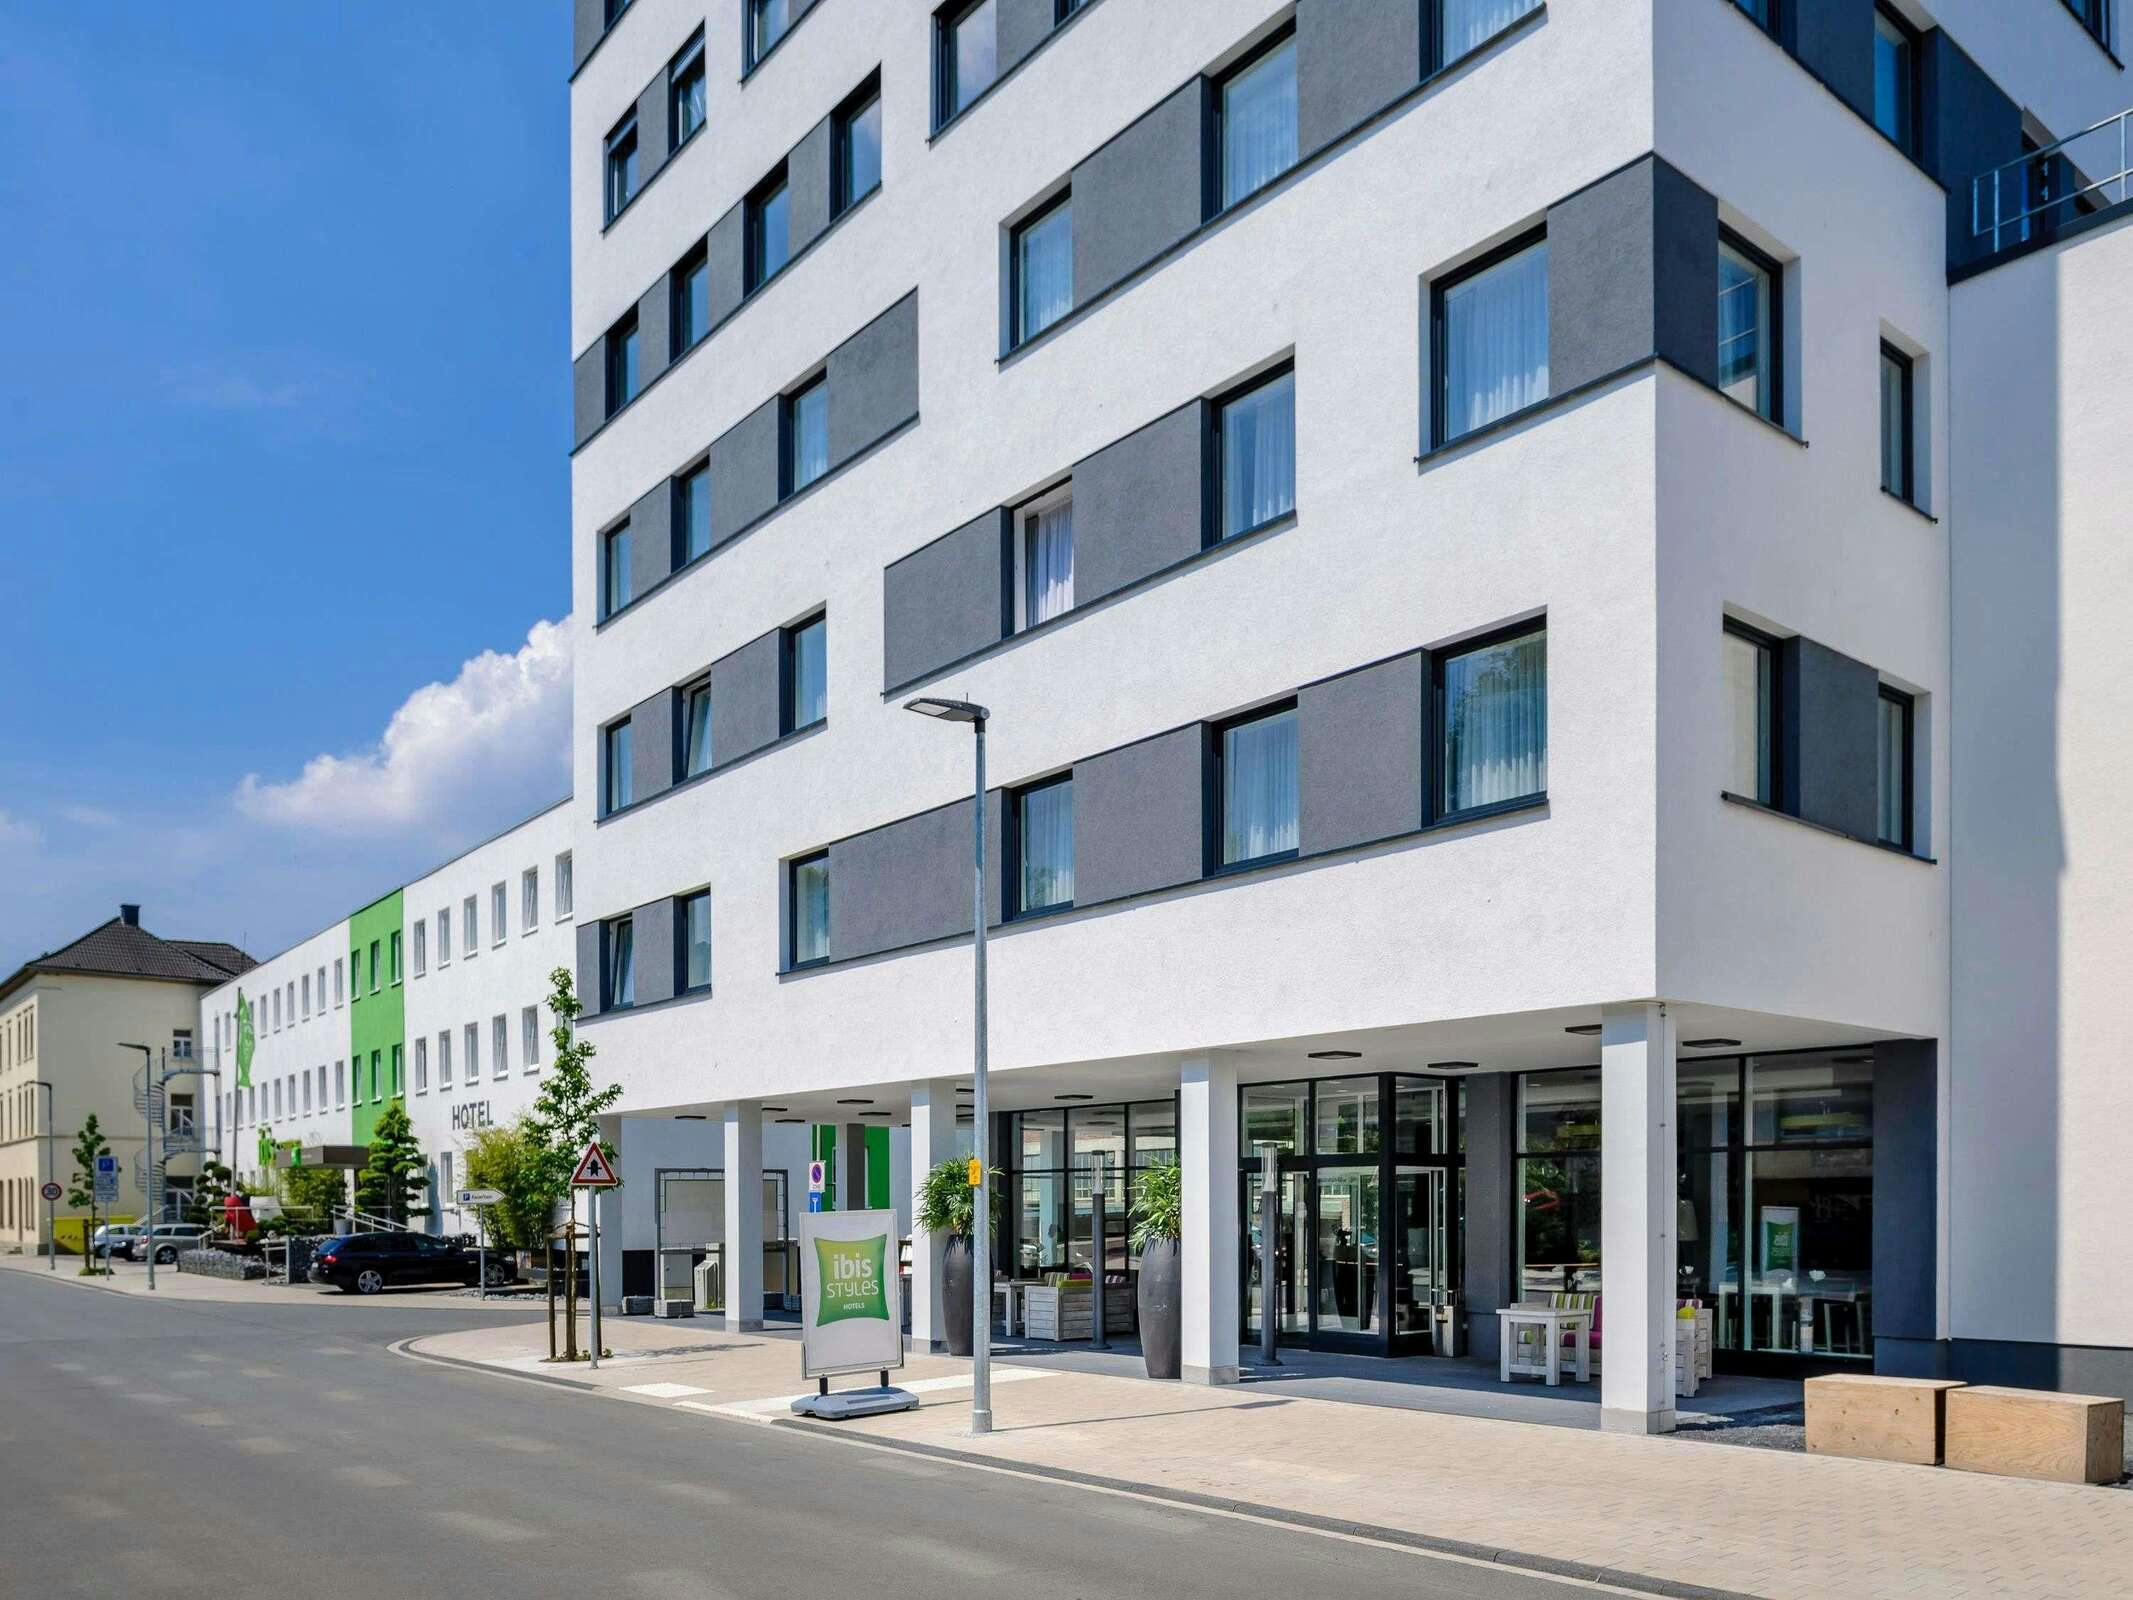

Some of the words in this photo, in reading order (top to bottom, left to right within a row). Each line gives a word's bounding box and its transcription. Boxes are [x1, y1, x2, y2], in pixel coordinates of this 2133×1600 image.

[452, 1100, 493, 1130] HOTEL
[833, 1252, 873, 1280] ibis
[843, 1301, 865, 1310] HOTELS
